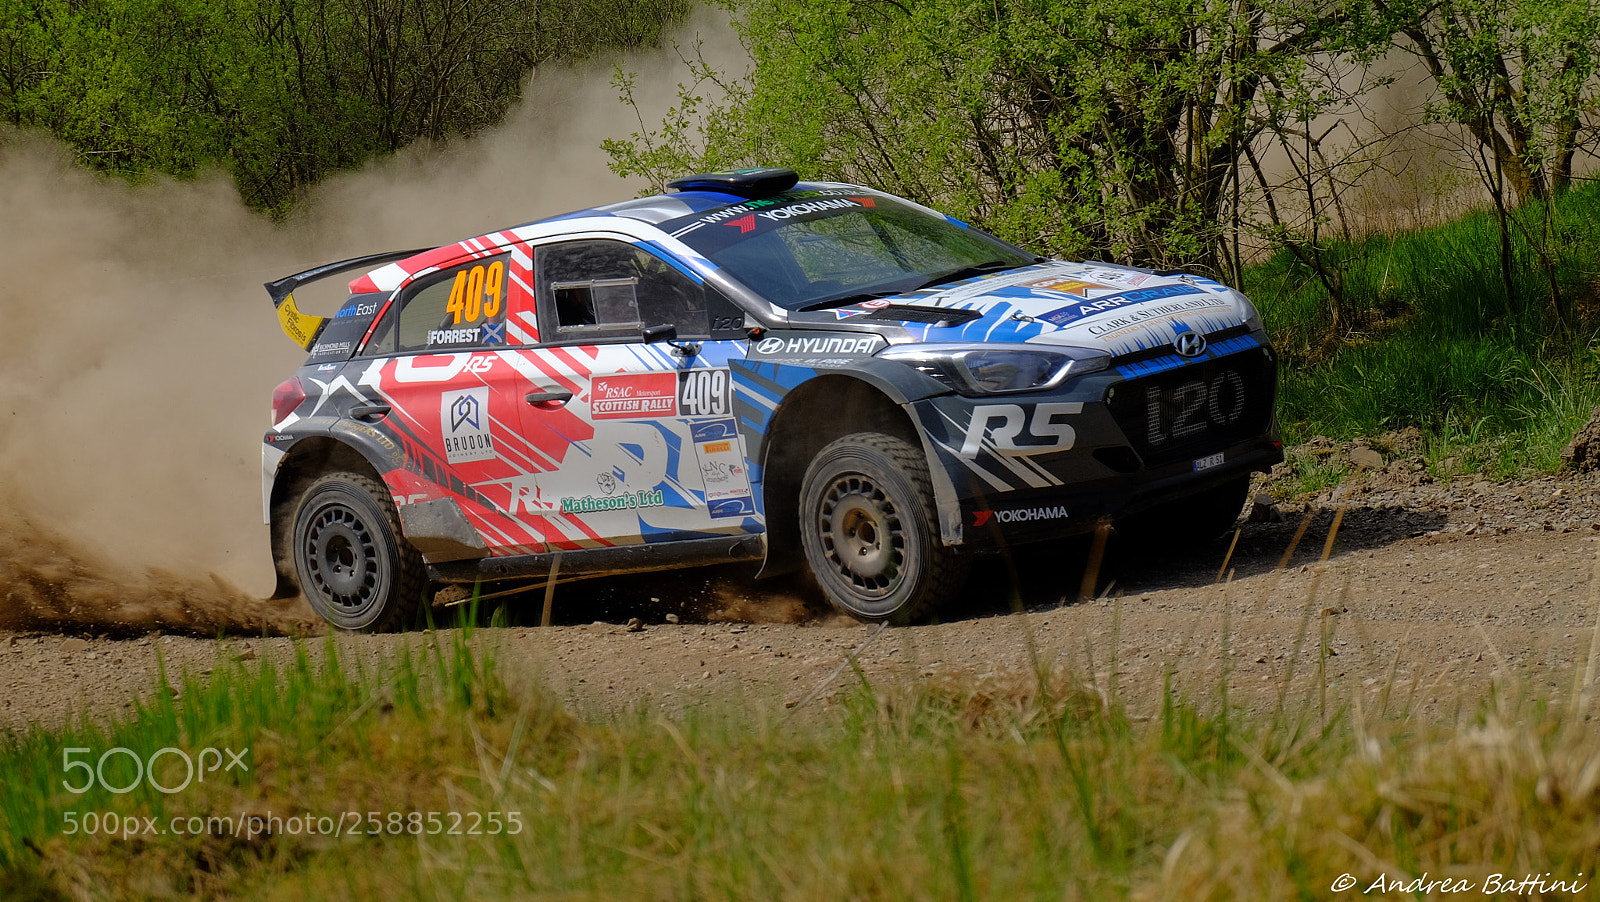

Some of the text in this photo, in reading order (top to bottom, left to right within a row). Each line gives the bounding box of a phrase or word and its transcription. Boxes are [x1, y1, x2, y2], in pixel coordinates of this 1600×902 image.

[758, 198, 861, 222] YOKOHAMA
[446, 260, 504, 324] 409
[1088, 316, 1131, 335] CLARK
[1130, 314, 1140, 322] &
[1140, 298, 1206, 319] SUTHERLAND
[431, 328, 480, 344] FORREST
[785, 338, 877, 353] HYUNDAI
[605, 387, 632, 398] RSAC
[682, 371, 725, 415] 409
[592, 399, 673, 414] SCOTTISH RALLY
[960, 402, 1084, 459] R5
[446, 433, 491, 452] BRUDON
[562, 491, 664, 513] Matheson's Ltd
[994, 506, 1068, 522] YOKOHAMA
